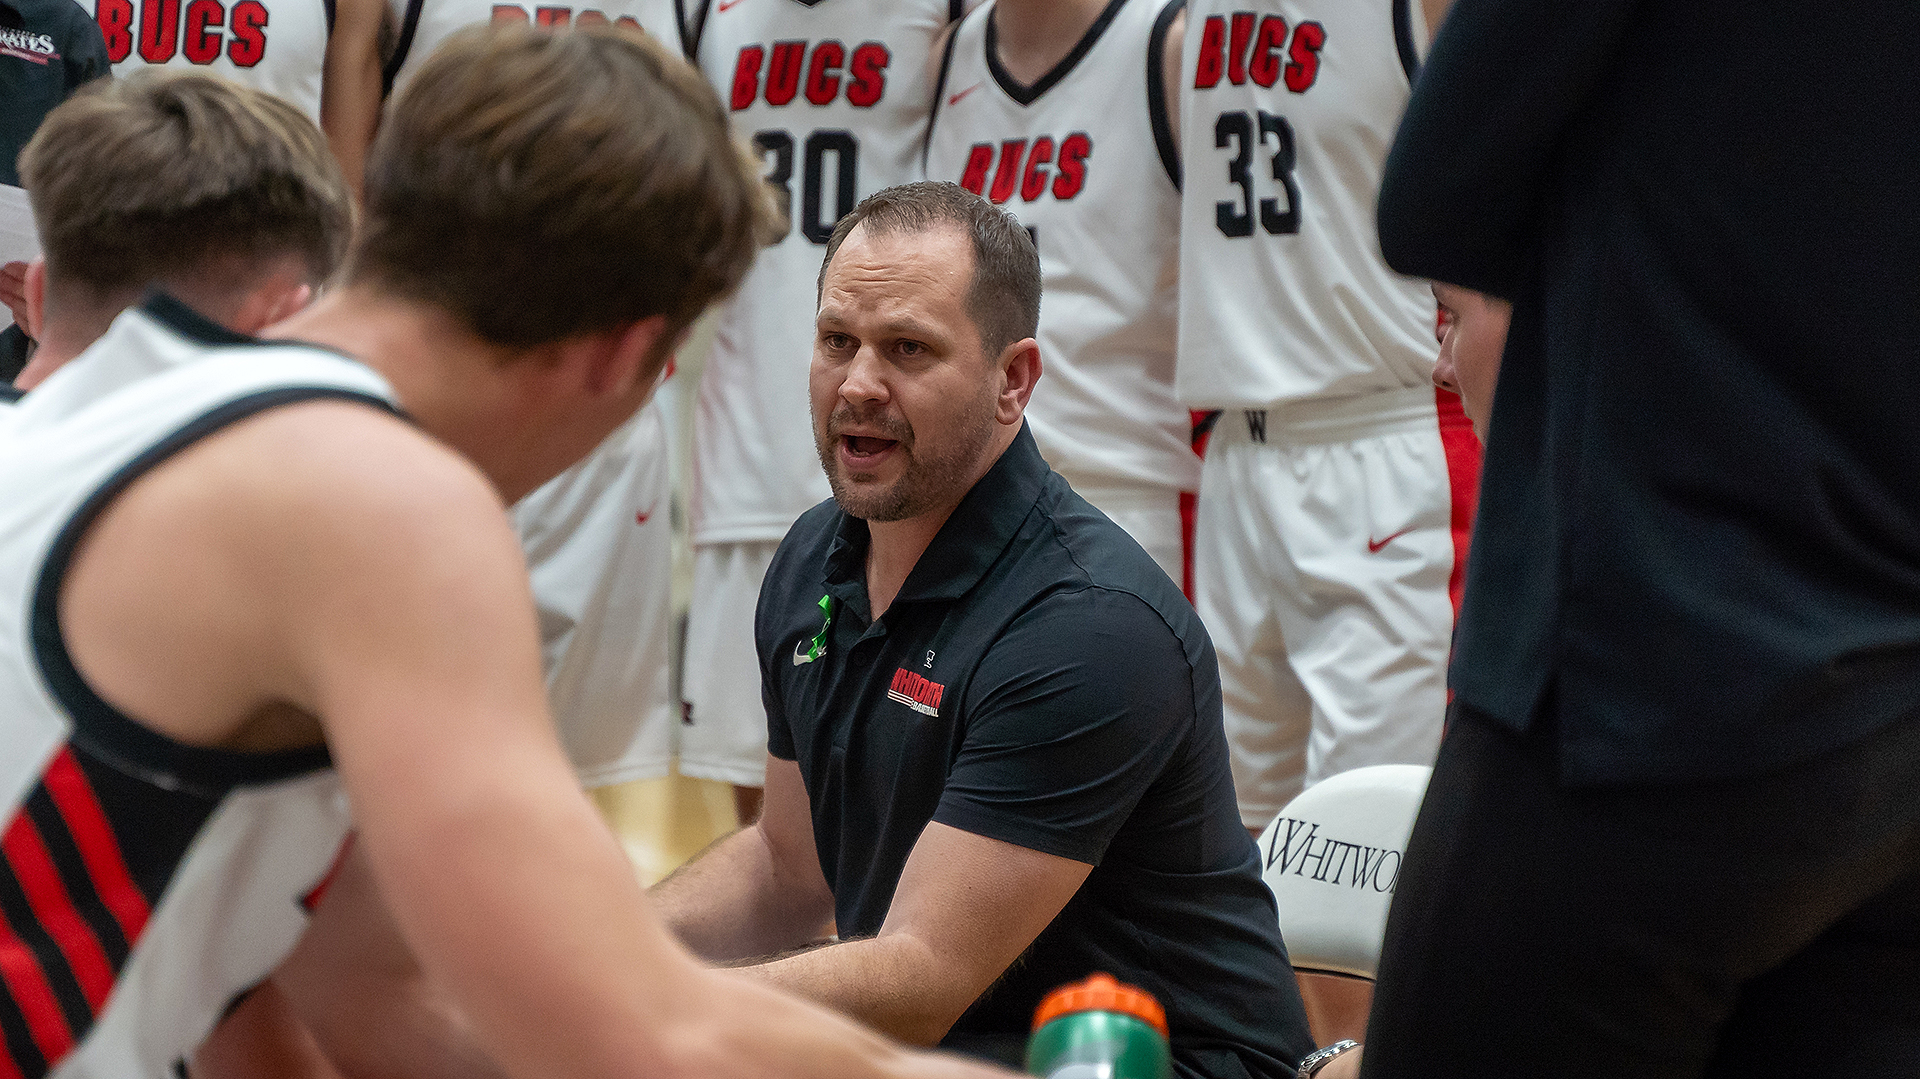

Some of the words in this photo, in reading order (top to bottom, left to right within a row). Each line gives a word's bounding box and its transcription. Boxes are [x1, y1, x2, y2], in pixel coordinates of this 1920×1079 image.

[95, 0, 268, 67] BUCS
[1194, 11, 1327, 94] BUCS
[729, 39, 890, 112] BUCS
[959, 131, 1092, 205] BUCS
[1215, 111, 1302, 237] 33
[1244, 408, 1267, 443] W
[1266, 817, 1401, 893] WHITWO
